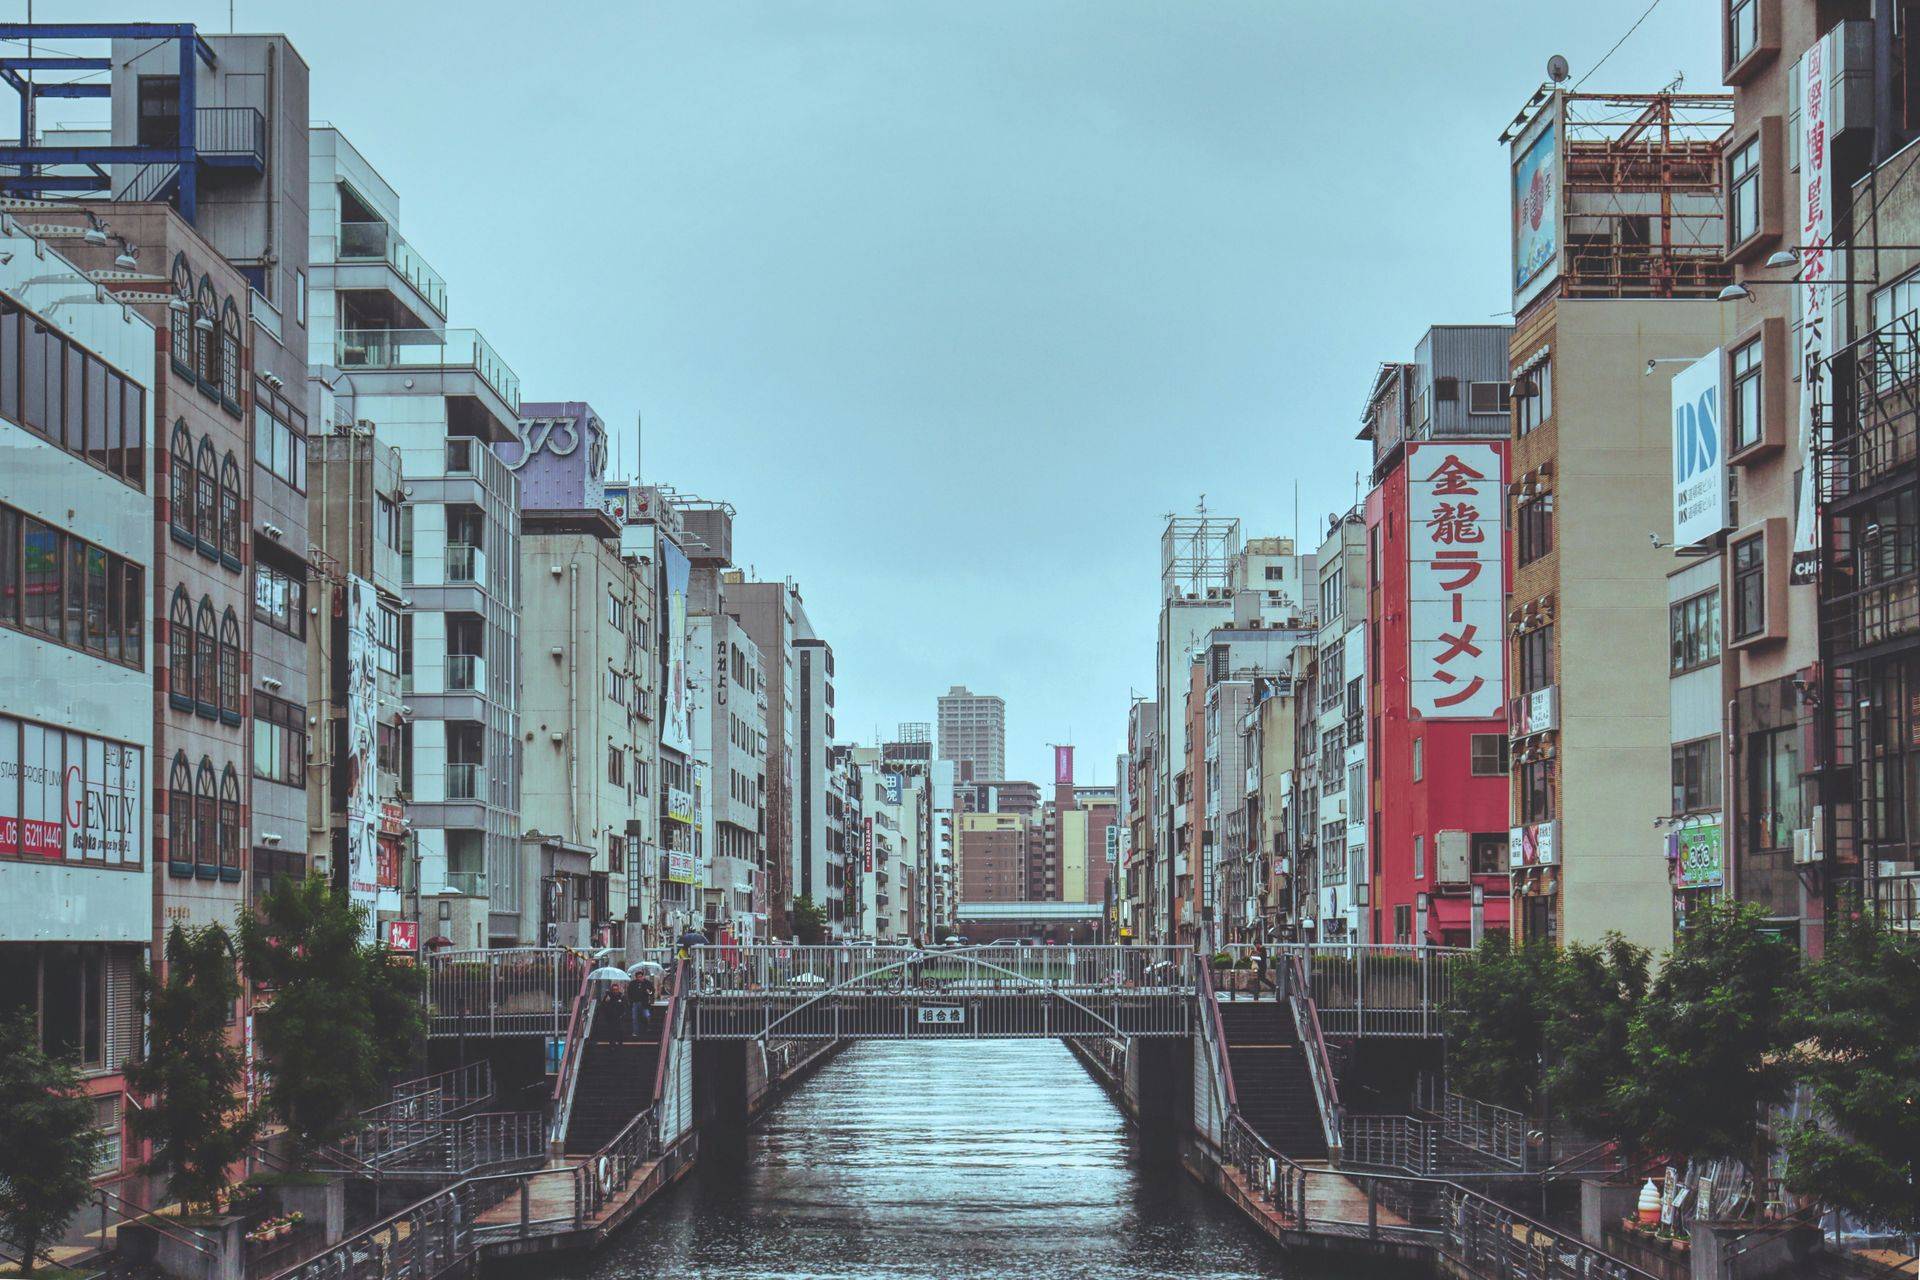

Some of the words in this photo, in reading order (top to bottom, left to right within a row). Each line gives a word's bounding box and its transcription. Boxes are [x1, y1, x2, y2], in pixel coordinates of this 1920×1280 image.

[1676, 385, 1717, 484] DS
[1426, 454, 1485, 709] 金龍ラーメン
[717, 640, 727, 706] かねよし
[6, 820, 18, 845] 06
[923, 1009, 960, 1022] 相合橋
